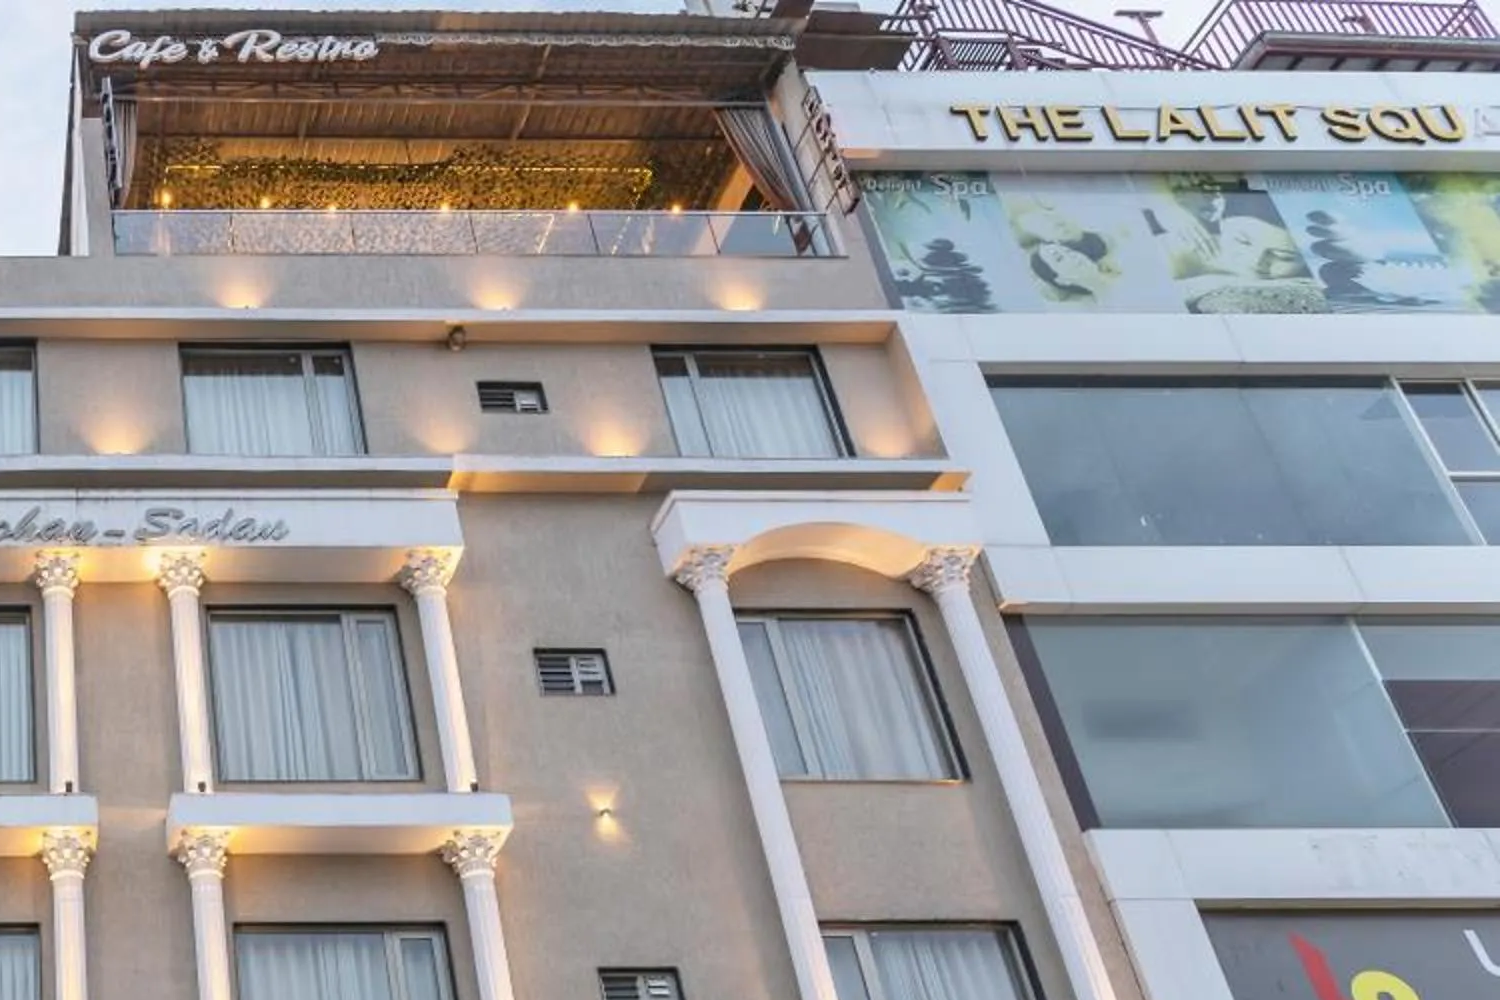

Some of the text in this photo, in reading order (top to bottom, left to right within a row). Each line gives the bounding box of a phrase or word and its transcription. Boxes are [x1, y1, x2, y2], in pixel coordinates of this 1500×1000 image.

[88, 29, 188, 69] Cafe
[198, 40, 219, 65] &
[950, 103, 1092, 142] THE
[1101, 103, 1301, 142] LALIT
[930, 174, 988, 200] Spa
[1338, 174, 1390, 199] Spa
